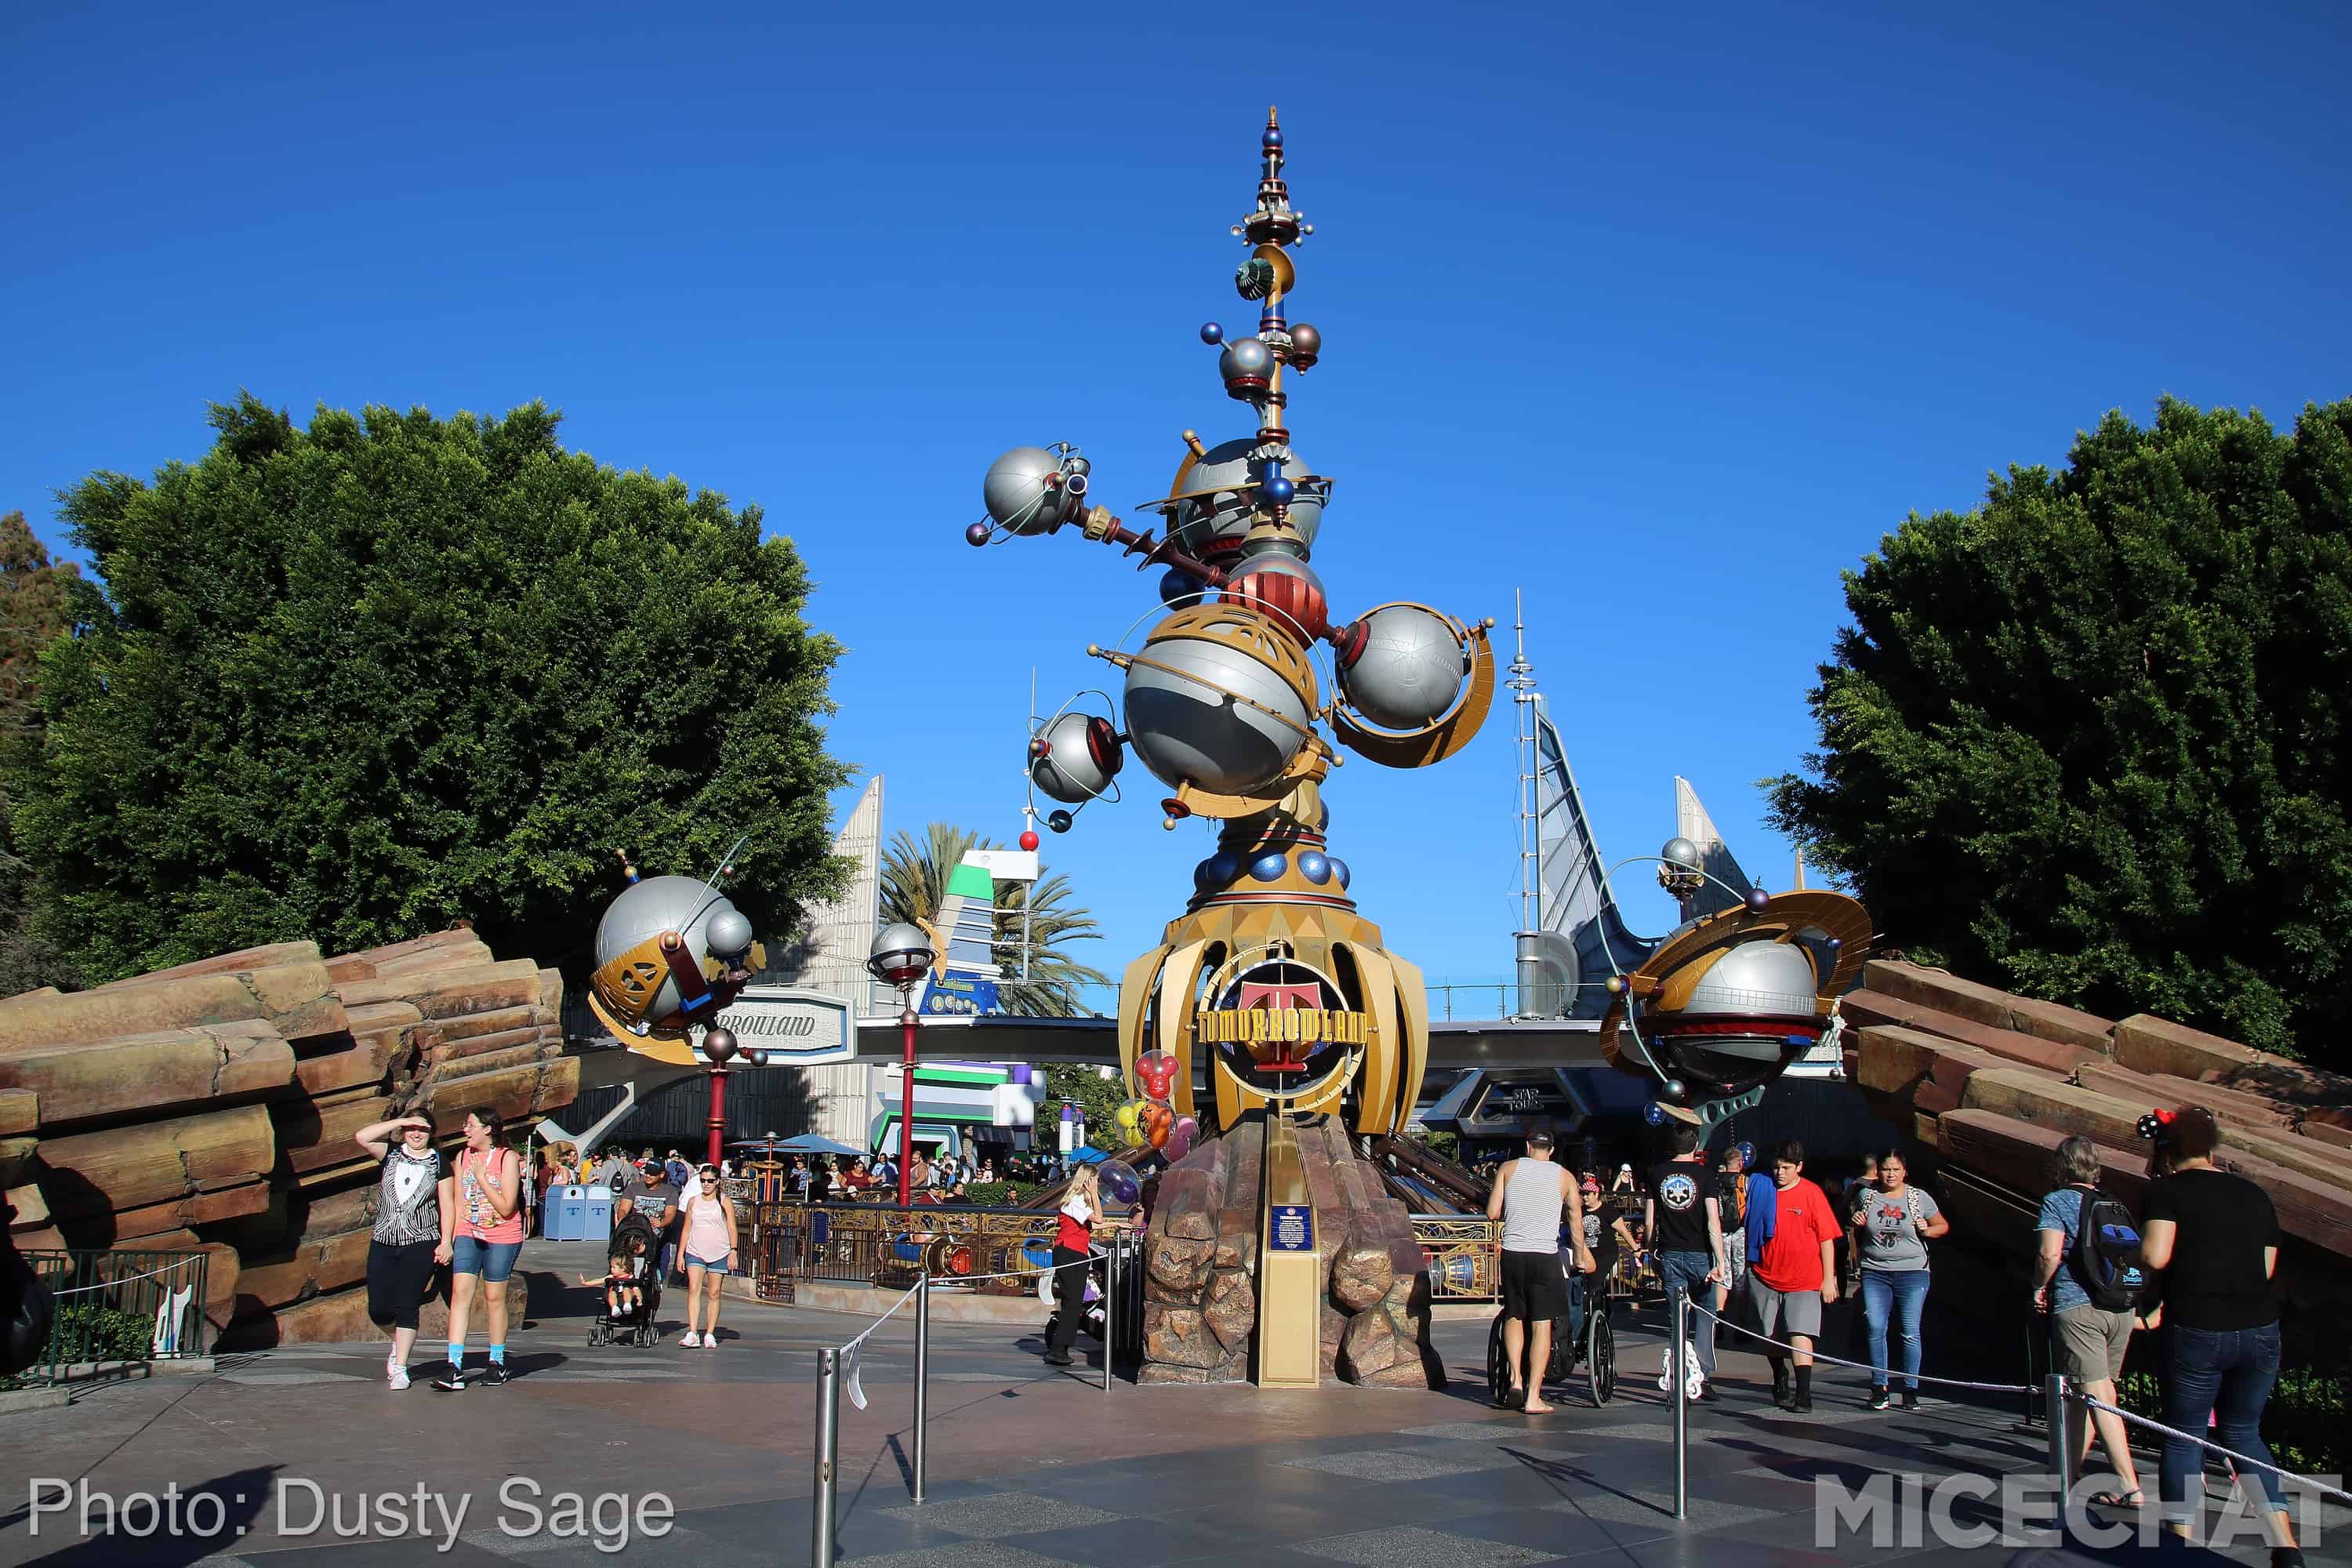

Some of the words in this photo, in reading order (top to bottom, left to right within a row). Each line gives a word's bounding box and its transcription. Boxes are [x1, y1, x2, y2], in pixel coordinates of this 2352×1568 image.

[1197, 1008, 1367, 1044] TOMORROWLAND
[566, 1207, 580, 1215] T
[591, 1207, 605, 1215] T
